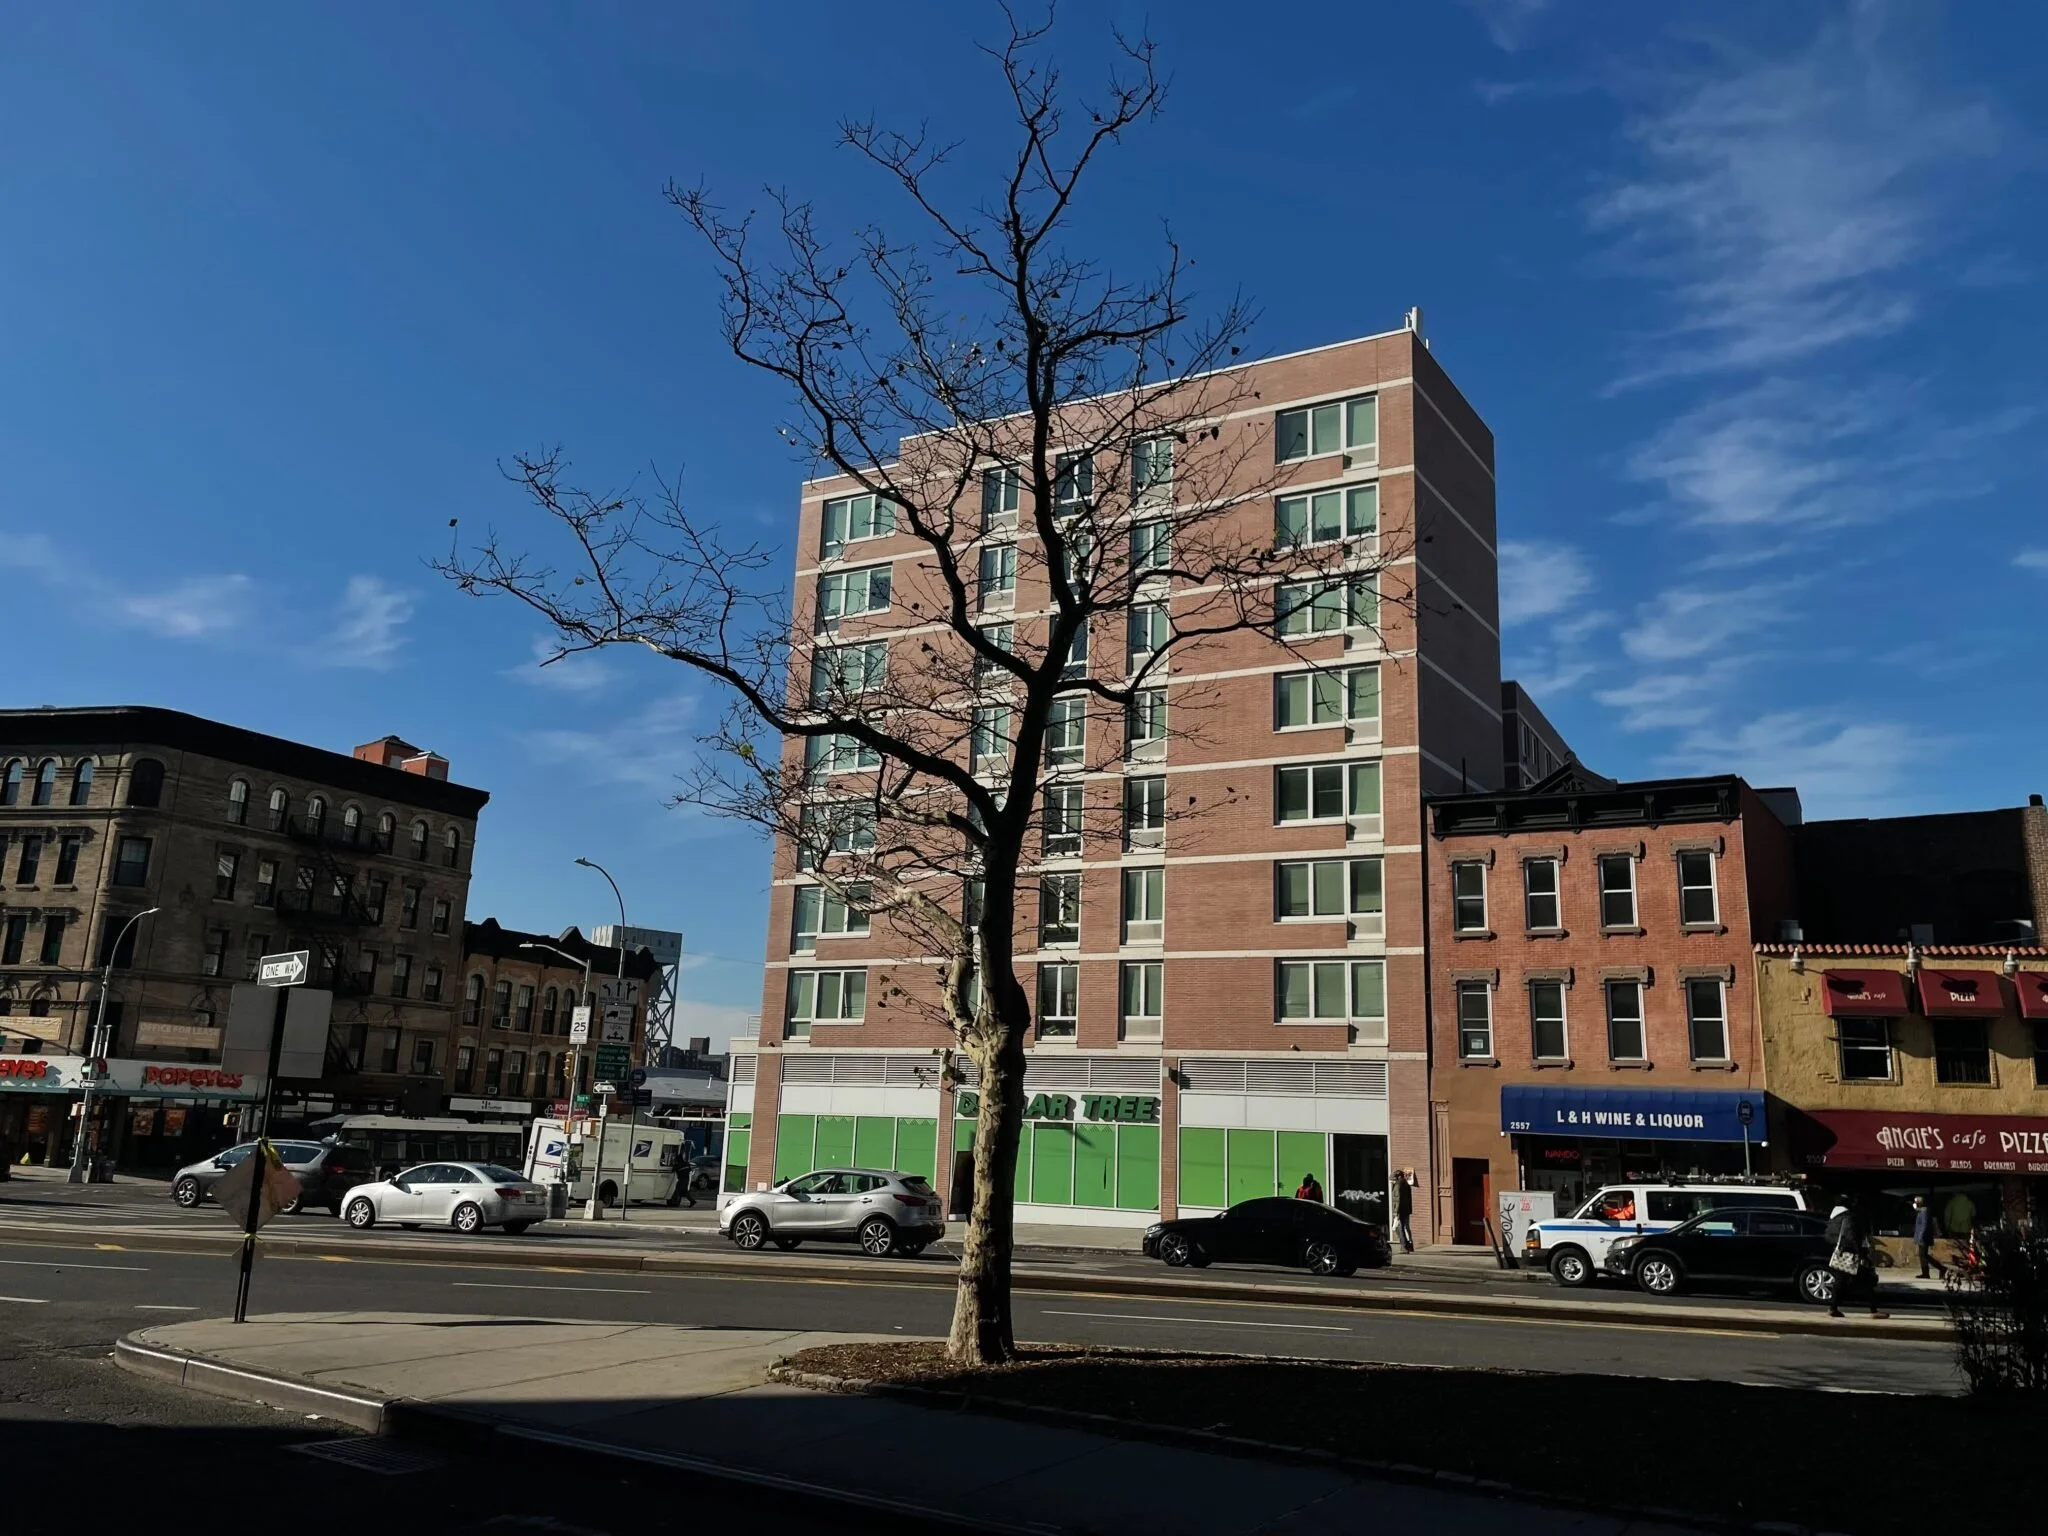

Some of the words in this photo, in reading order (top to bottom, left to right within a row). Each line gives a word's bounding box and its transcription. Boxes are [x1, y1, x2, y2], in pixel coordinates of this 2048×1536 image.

[265, 964, 280, 977] ONE
[284, 962, 299, 974] WAY
[140, 1023, 171, 1033] OFFICE
[573, 1022, 587, 1032] 25
[145, 1066, 243, 1088] POPEYES
[1081, 1094, 1156, 1120] TREE
[1510, 1121, 1531, 1131] 2557
[1557, 1110, 1565, 1123] L
[1568, 1111, 1578, 1124] &
[1582, 1111, 1591, 1124] H
[1594, 1112, 1631, 1126] WINE
[1635, 1113, 1646, 1127] &
[1649, 1113, 1704, 1129] LIQUOR
[1876, 1126, 1944, 1150] ANGIE'S
[1952, 1129, 1987, 1149] cafe
[1886, 1157, 1905, 1167] PIZZA
[1915, 1158, 1939, 1168] WRAPS
[1950, 1160, 1972, 1169] SALADS
